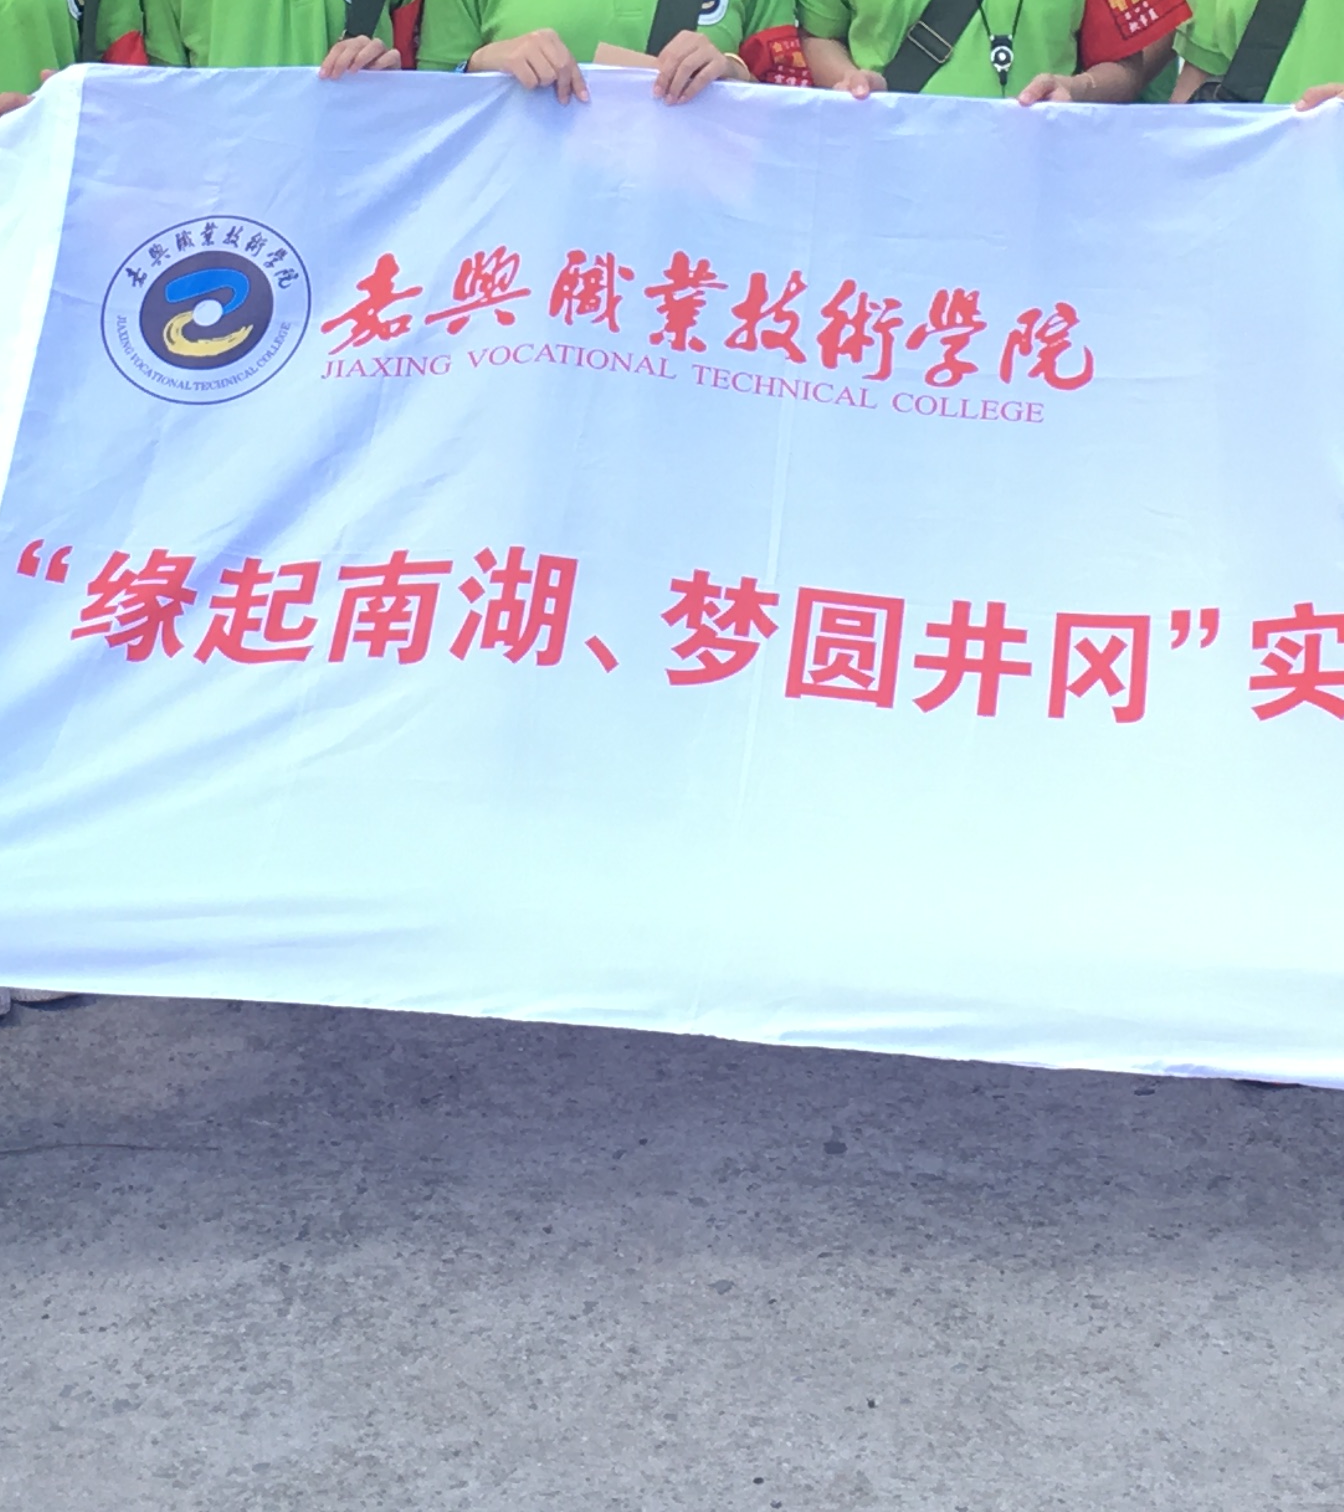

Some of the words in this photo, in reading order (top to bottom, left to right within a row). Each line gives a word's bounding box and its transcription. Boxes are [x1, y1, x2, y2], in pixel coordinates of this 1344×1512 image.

[320, 354, 452, 380] JIAXING
[467, 342, 677, 380] VOCATIONAL
[692, 364, 879, 410] TECHNICAL
[891, 391, 1045, 424] COLLEGE
